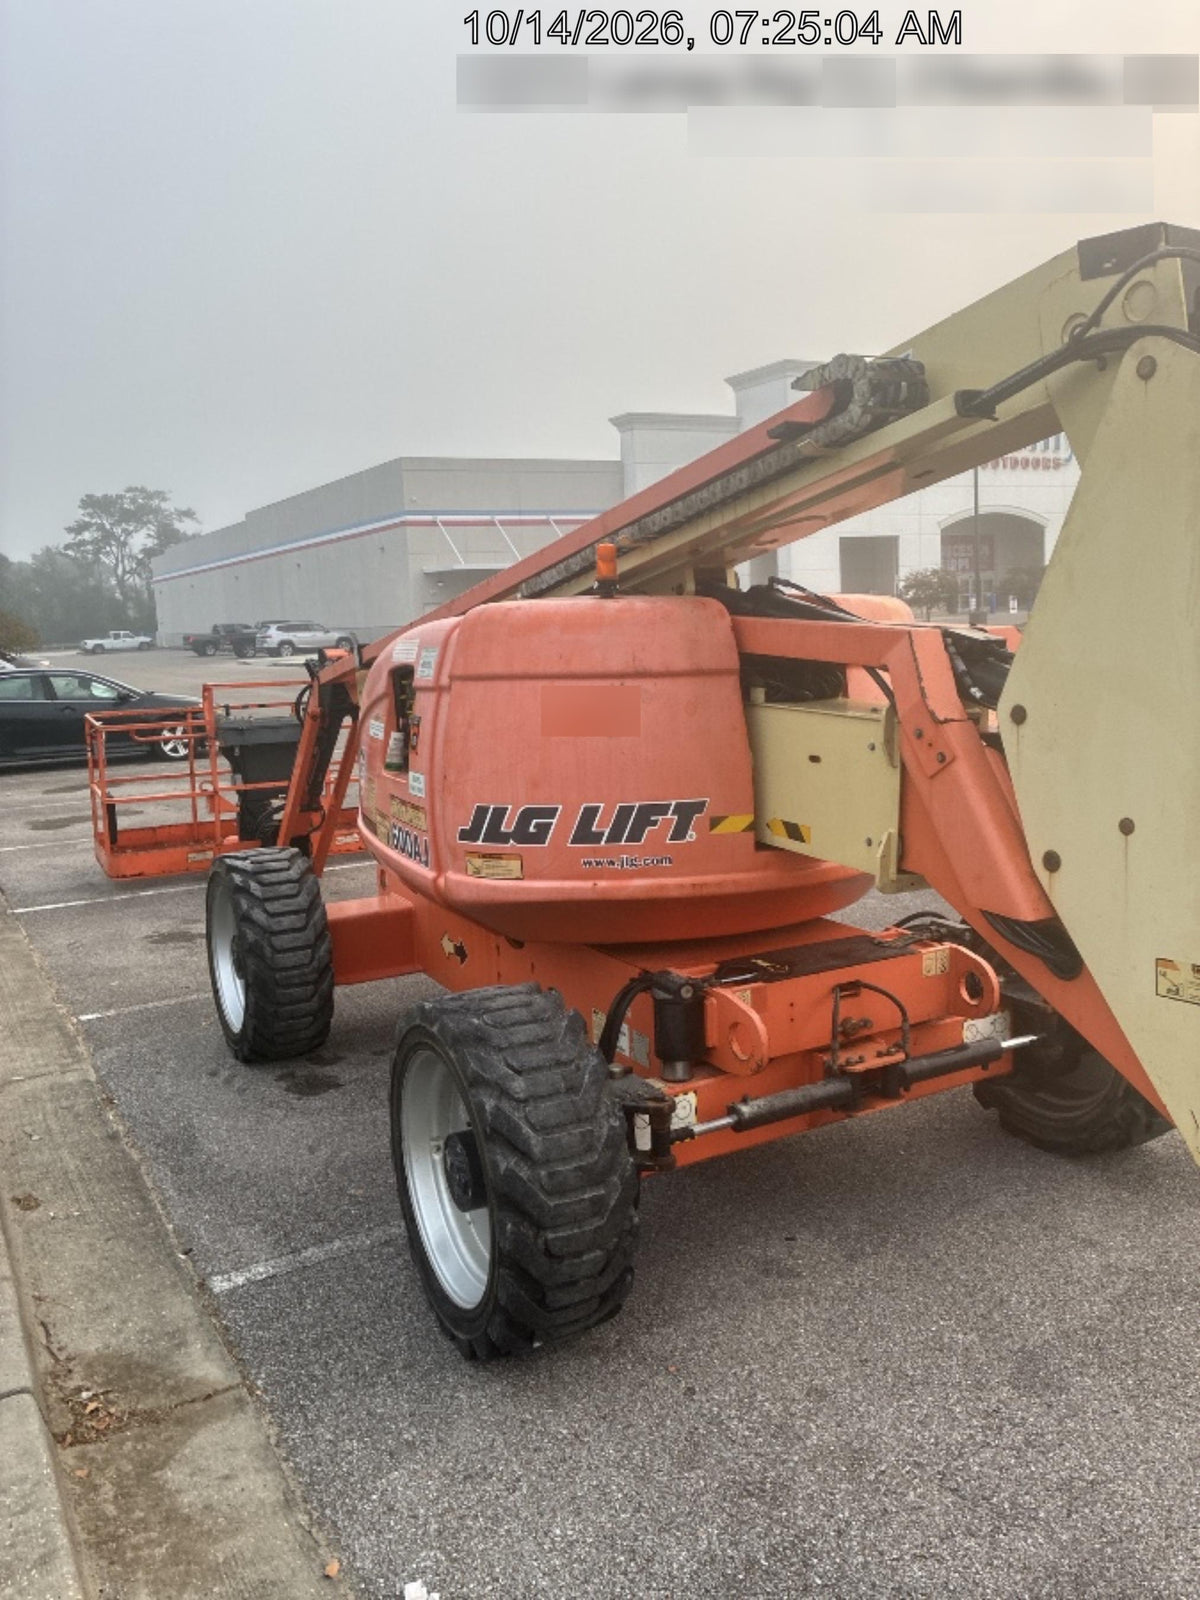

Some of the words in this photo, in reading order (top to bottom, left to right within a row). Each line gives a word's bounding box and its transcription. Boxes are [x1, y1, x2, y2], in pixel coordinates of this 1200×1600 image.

[457, 803, 562, 847] JLG
[567, 799, 710, 847] LIFT
[581, 854, 673, 870] www.jlg.com
